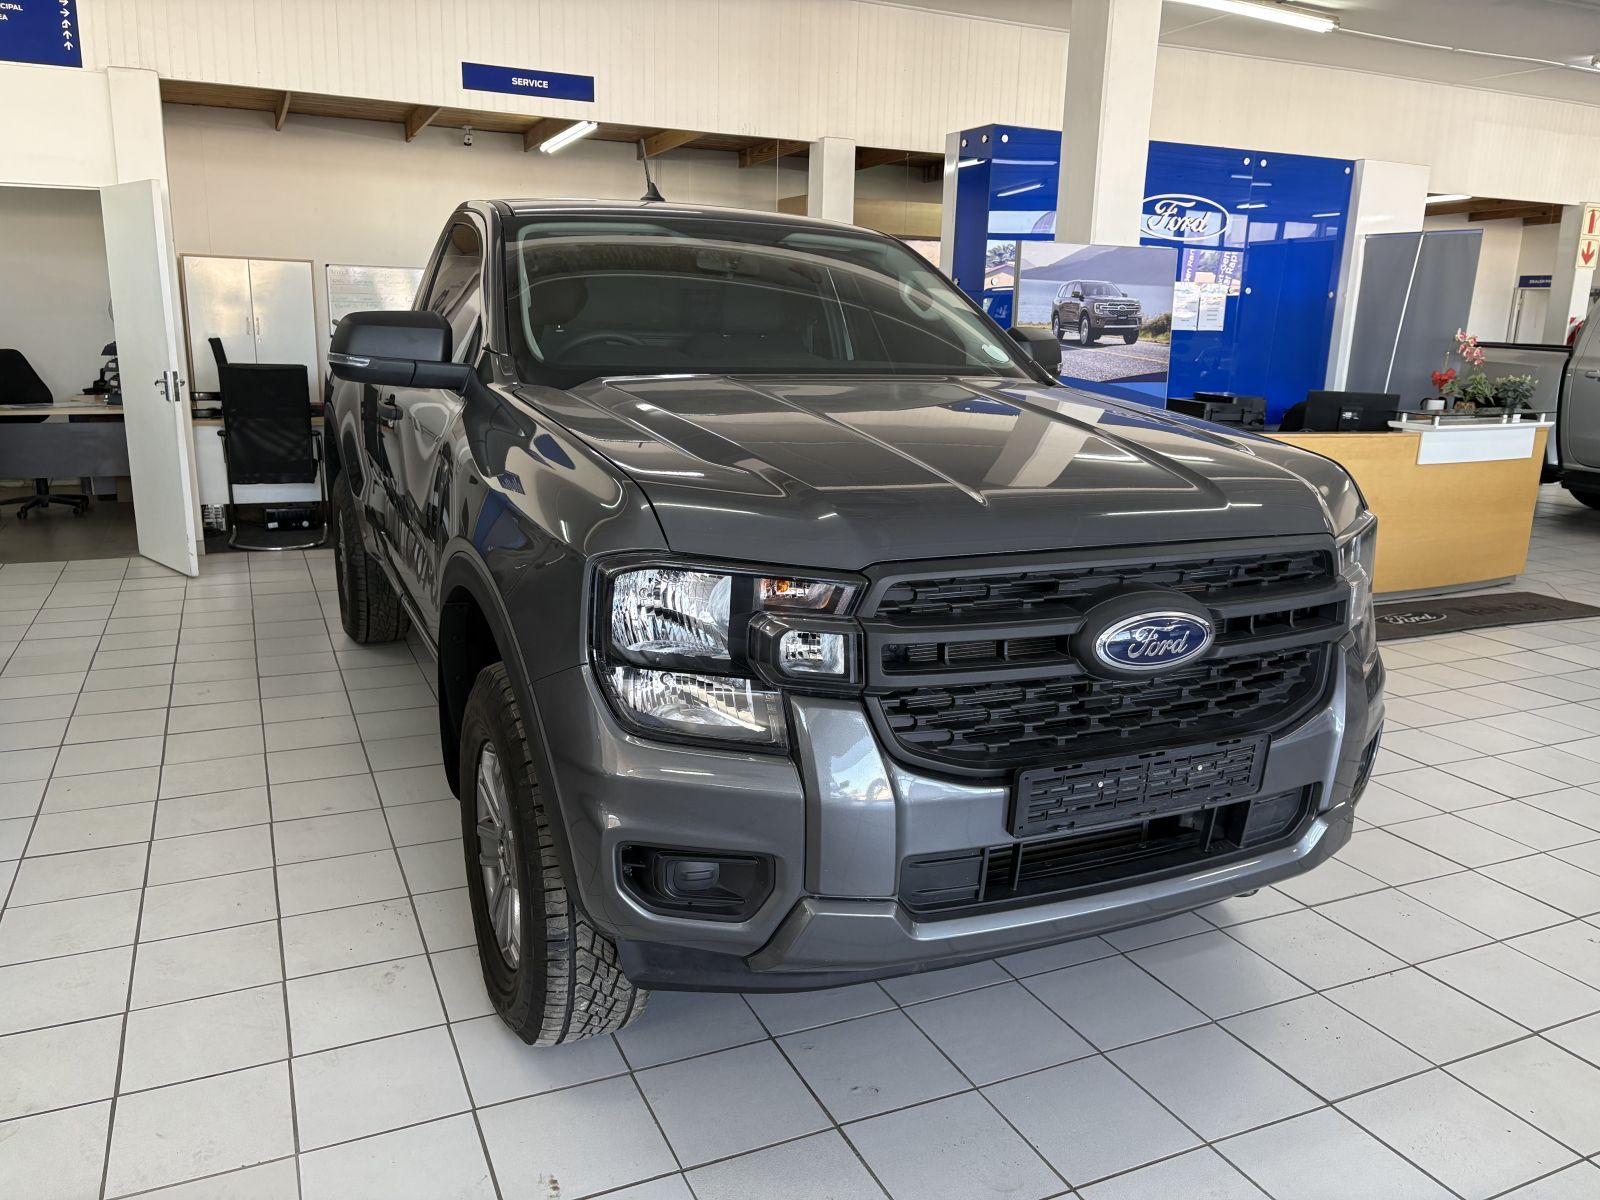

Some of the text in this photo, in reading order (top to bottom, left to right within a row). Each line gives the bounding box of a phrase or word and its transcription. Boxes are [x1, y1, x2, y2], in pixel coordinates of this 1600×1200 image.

[511, 77, 549, 89] SERVICE
[1147, 200, 1208, 232] Ford
[1384, 612, 1438, 625] Ford
[1127, 624, 1190, 659] Ford
